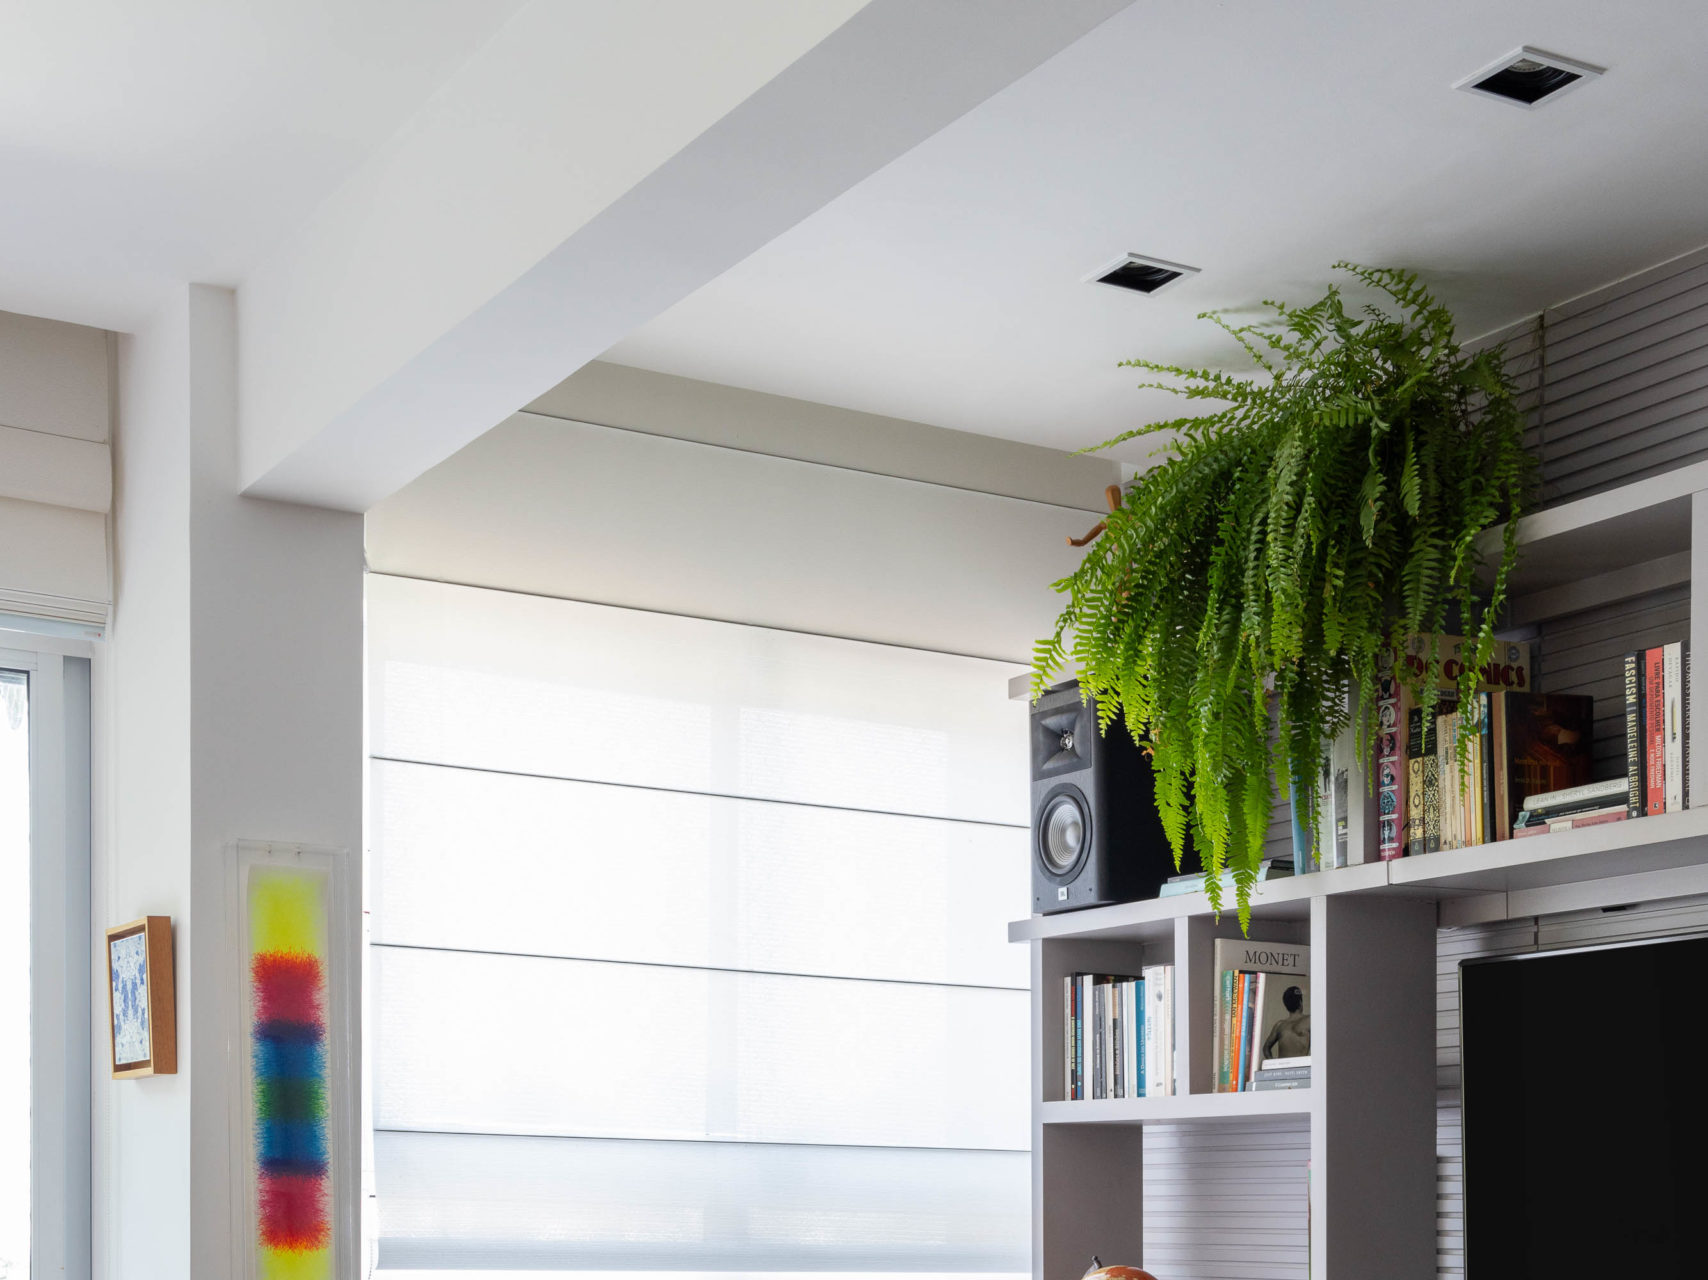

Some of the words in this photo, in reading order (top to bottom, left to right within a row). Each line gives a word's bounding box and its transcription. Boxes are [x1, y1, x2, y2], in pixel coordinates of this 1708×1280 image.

[1624, 656, 1637, 704] FASCISM
[1626, 713, 1638, 762] MADELEINE
[1628, 764, 1640, 808] ALBRIGHT
[1244, 950, 1300, 967] MONET
